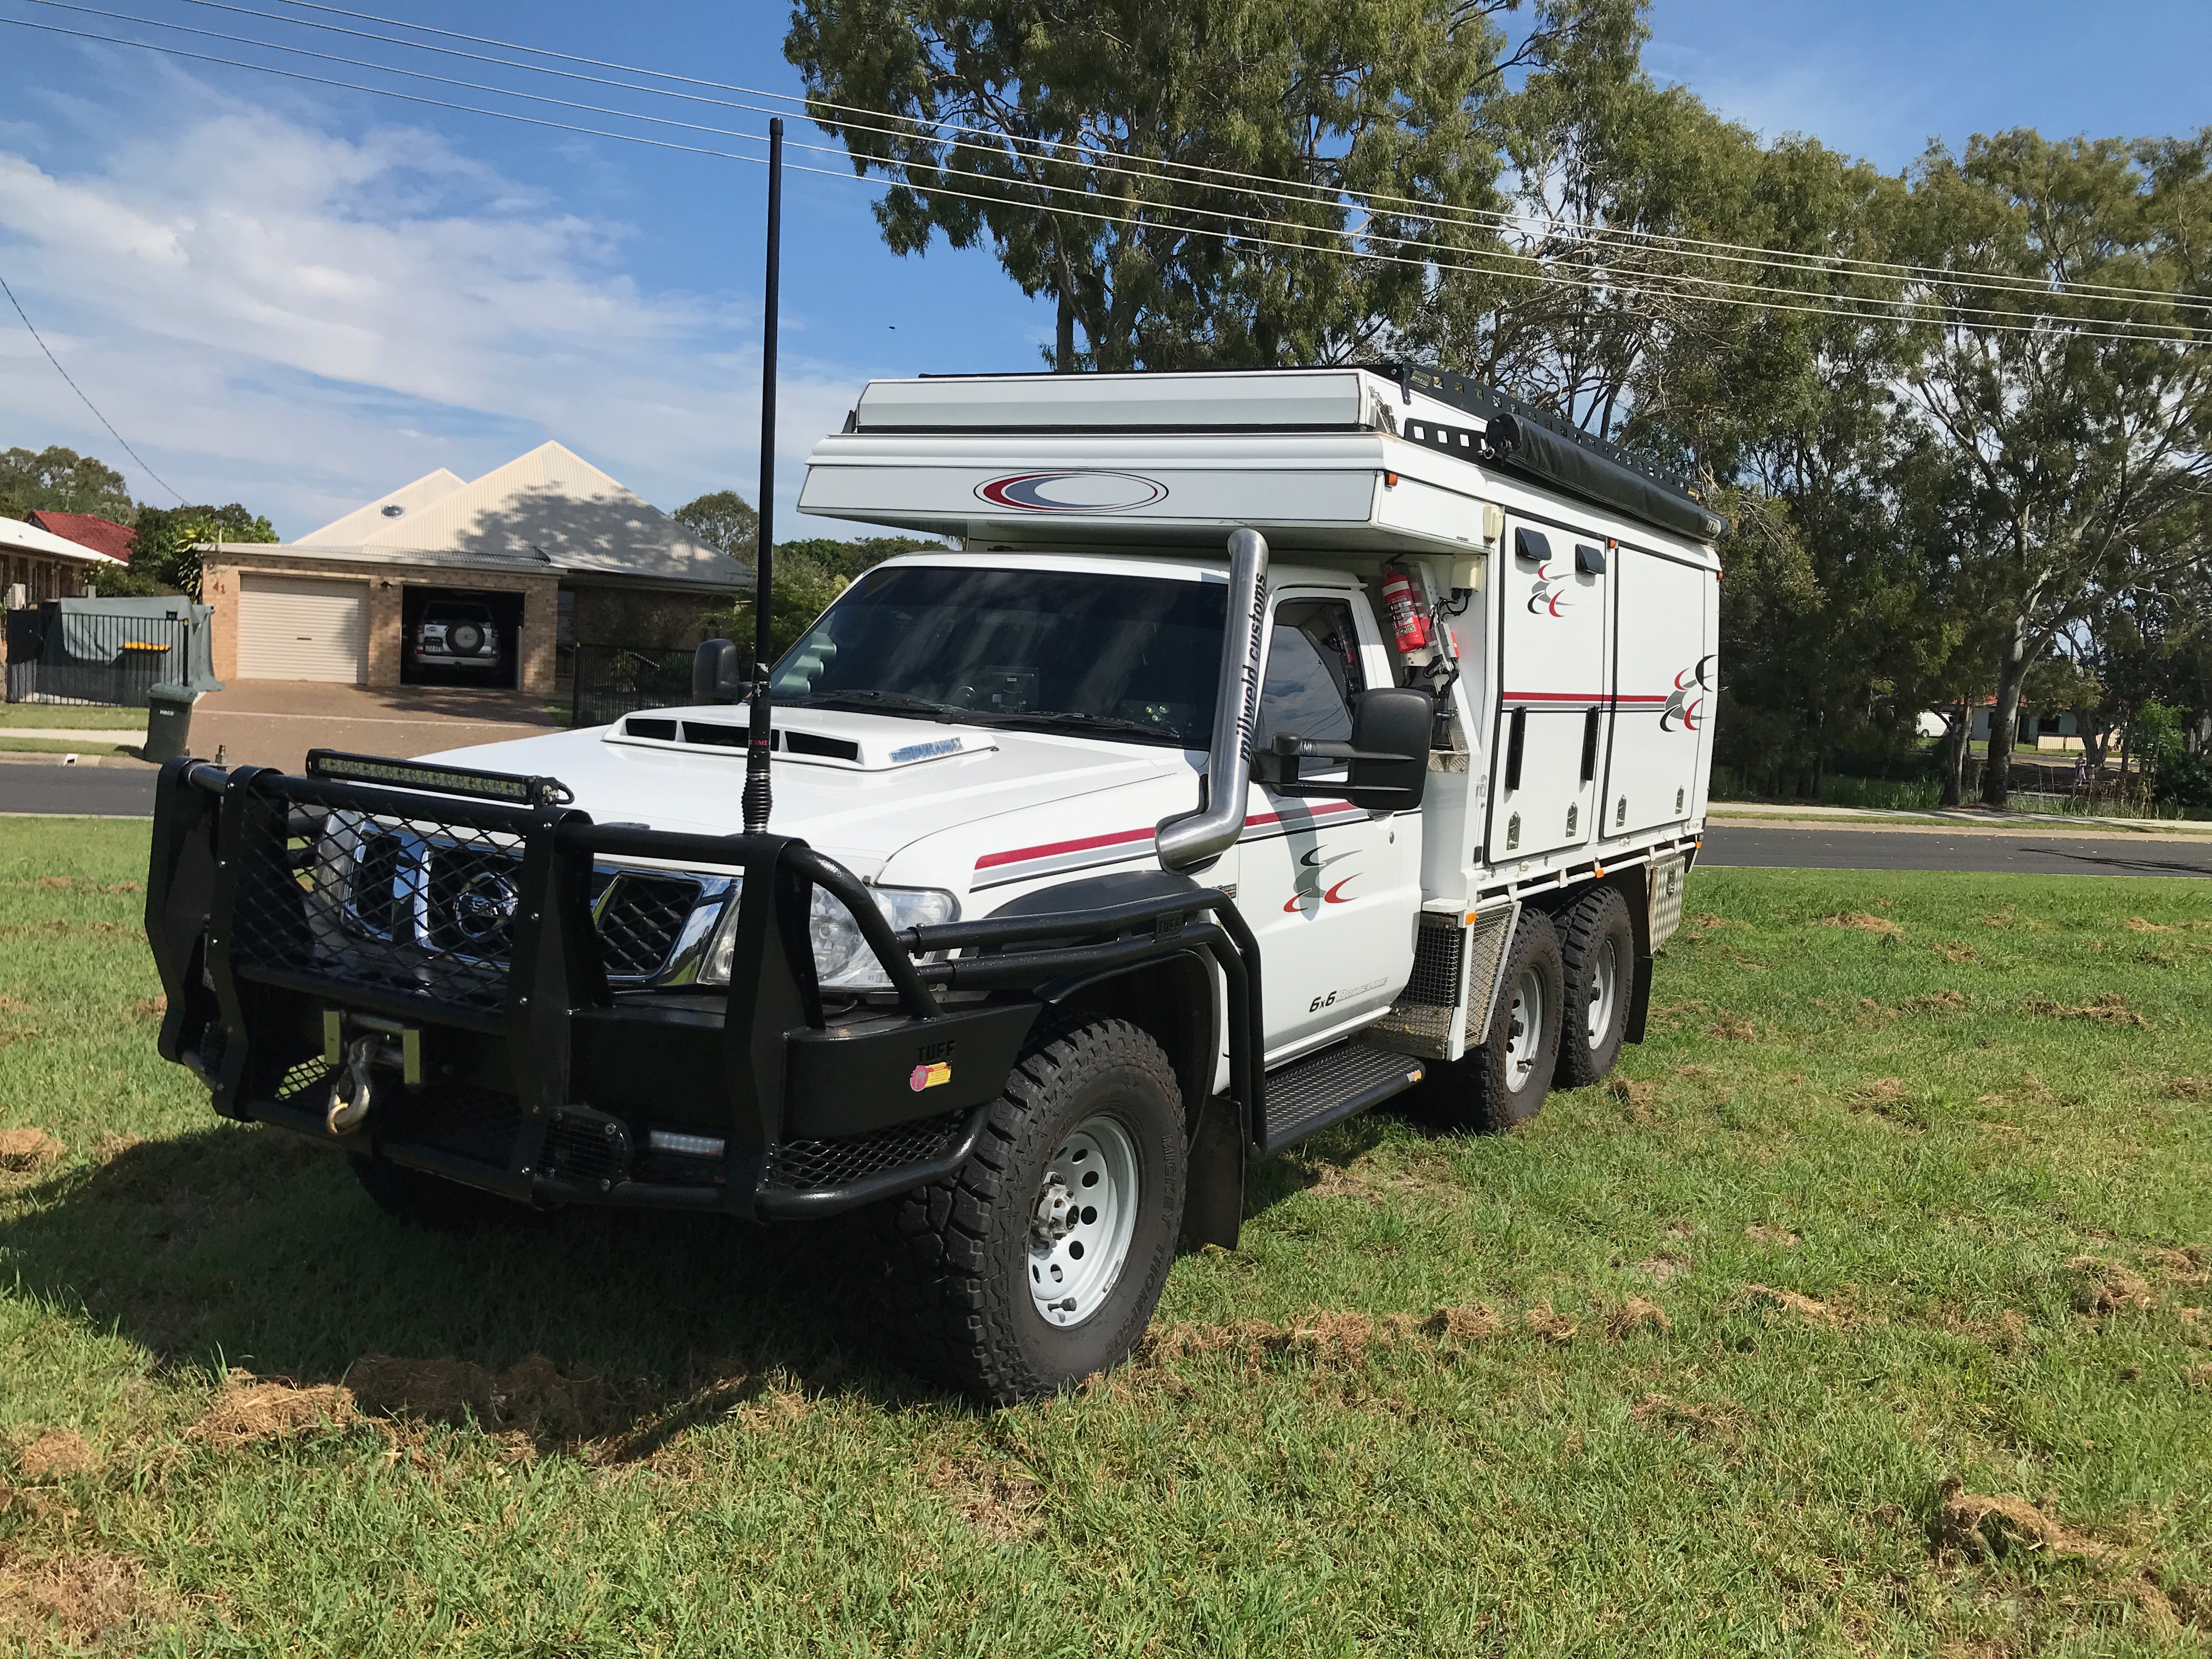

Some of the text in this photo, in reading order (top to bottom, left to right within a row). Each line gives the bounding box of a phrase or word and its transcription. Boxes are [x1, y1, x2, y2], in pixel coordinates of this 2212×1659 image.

[213, 580, 225, 594] 41
[1237, 572, 1266, 764] millweld customs
[911, 737, 964, 760] DURAMAX
[916, 1040, 956, 1063] TUFF
[1105, 1135, 1177, 1358] MICKEY THOMPSON
